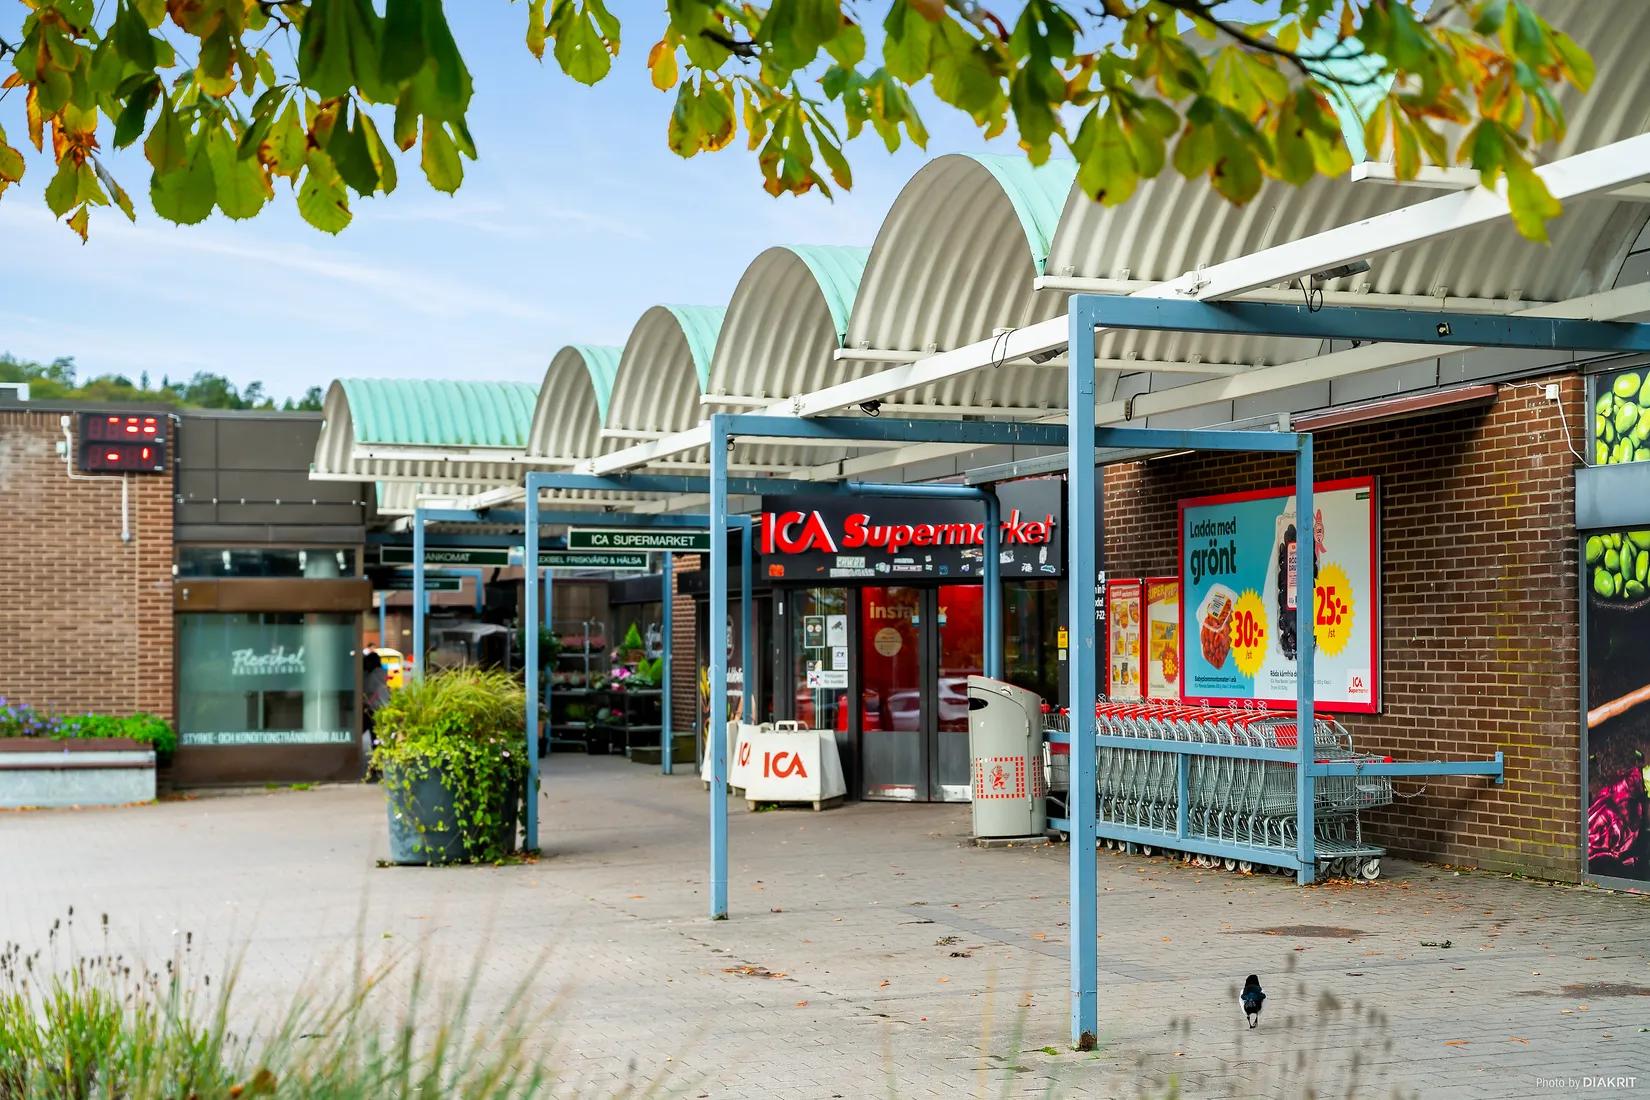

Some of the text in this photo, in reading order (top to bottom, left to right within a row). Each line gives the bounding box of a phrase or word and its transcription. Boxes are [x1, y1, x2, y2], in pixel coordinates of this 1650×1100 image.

[762, 510, 838, 553] ICA
[1190, 516, 1236, 538] Ladda med
[591, 534, 695, 547] ICA SUPERMARKET
[423, 552, 470, 562] ANKOMAT
[538, 554, 642, 565] EXIBEL FRISKVÅRD & HÄLSA
[1190, 538, 1237, 585] grönt
[1316, 586, 1348, 625] 25:-
[1234, 610, 1264, 648] 30:-
[1328, 628, 1336, 638] /st
[231, 645, 304, 667] Flexibel
[1245, 650, 1253, 660] /st
[1352, 676, 1364, 688] ICA
[218, 732, 234, 744] OCH
[330, 731, 351, 743] ALLA
[737, 742, 751, 767] IC
[763, 751, 808, 778] ICA
